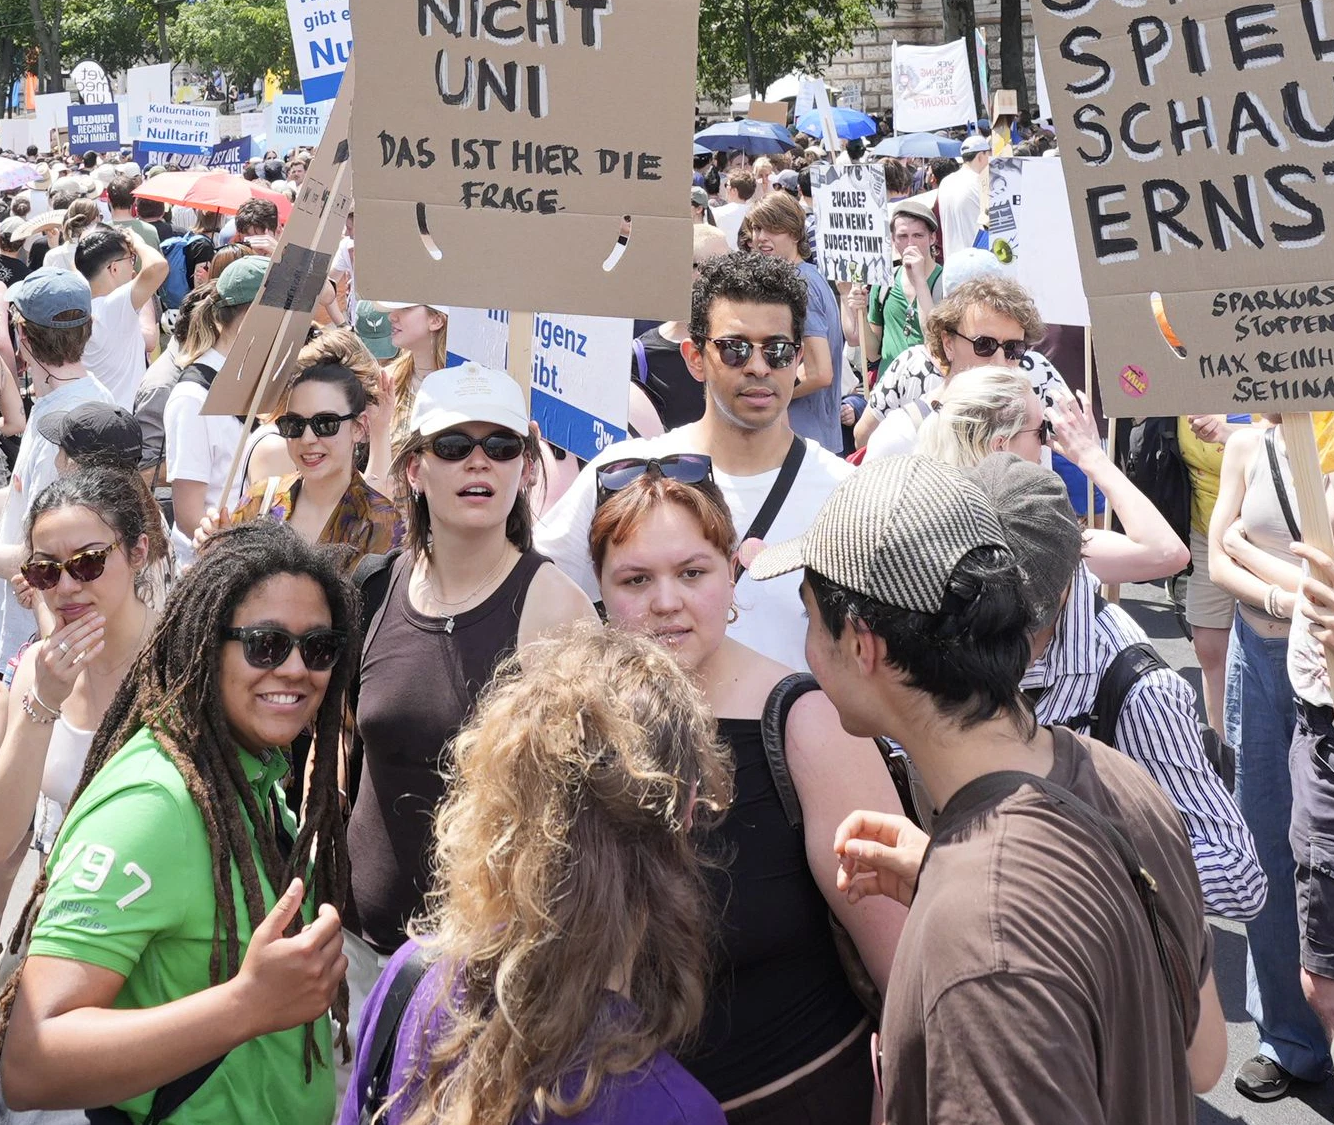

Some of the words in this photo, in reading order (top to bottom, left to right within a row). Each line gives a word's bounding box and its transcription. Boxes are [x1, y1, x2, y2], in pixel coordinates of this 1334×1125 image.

[304, 10, 337, 32] gibt
[342, 9, 350, 21] e
[309, 37, 353, 69] Nu
[435, 49, 549, 118] UNI
[72, 114, 114, 126] BILDUNG
[149, 104, 211, 118] Kulturnation
[277, 116, 320, 125] SCHAFFT
[280, 106, 317, 115] WISSEN
[77, 123, 110, 135] RECHNET
[147, 116, 162, 124] gibt
[174, 118, 193, 126] nicht
[276, 125, 320, 135] INNOVATION!
[71, 134, 89, 144] SICH
[90, 132, 117, 143] IMMER!
[147, 127, 208, 143] Nulltarif!
[148, 151, 211, 168] BILDUNG
[211, 149, 225, 164] IST
[224, 146, 240, 162] DIE
[377, 130, 436, 169] DAS
[452, 138, 502, 171] IST
[512, 139, 582, 175] HIER
[595, 149, 663, 181] DIE
[831, 191, 866, 208] ZUGABE?
[829, 213, 844, 229] NUR
[845, 211, 874, 231] WENN'S
[824, 234, 852, 251] BUDGET
[853, 236, 883, 254] STIMMT
[535, 312, 587, 357] igenz
[531, 356, 563, 395] ibt.
[1200, 352, 1247, 379] MAX
[1122, 370, 1147, 392] Mut
